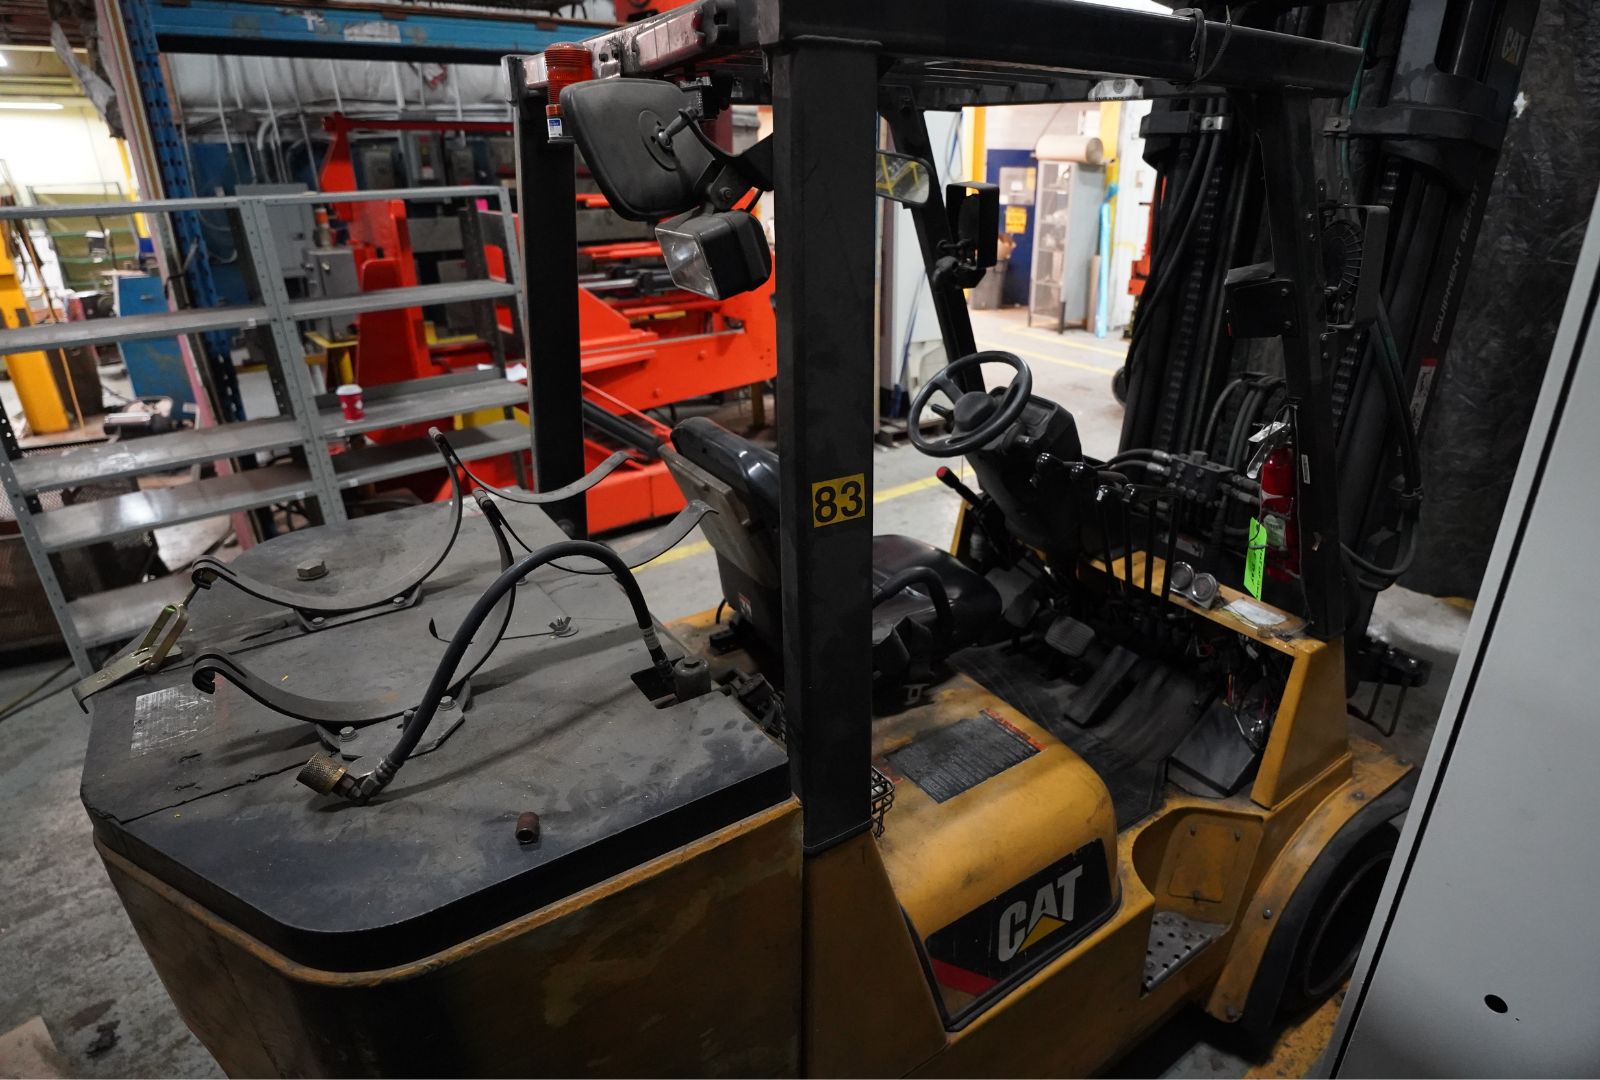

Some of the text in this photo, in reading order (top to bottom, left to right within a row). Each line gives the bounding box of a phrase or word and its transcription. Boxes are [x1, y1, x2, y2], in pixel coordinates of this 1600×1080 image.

[1502, 27, 1526, 66] CAT
[1432, 181, 1480, 344] EQUIPMENT DEPOT
[815, 481, 862, 522] 83
[998, 864, 1083, 962] CAT
